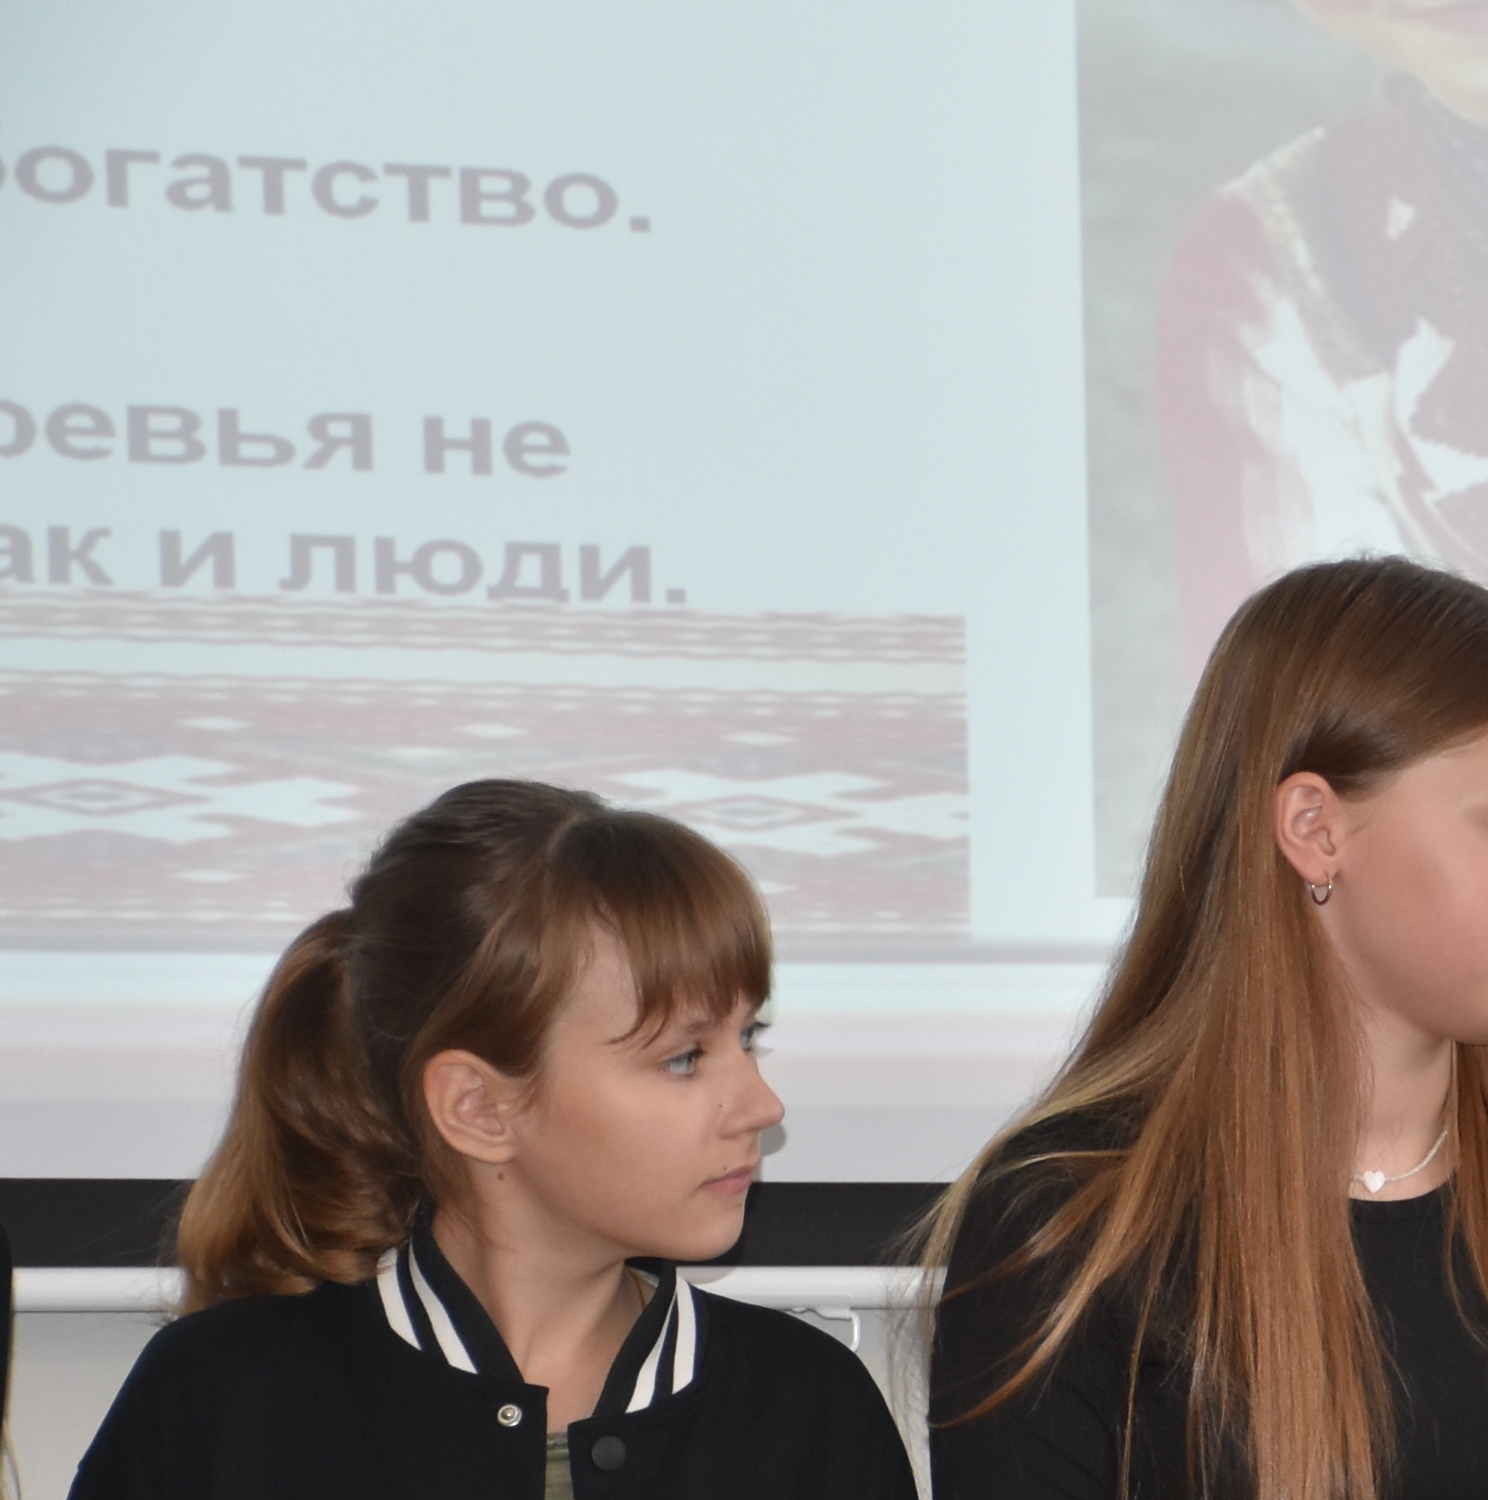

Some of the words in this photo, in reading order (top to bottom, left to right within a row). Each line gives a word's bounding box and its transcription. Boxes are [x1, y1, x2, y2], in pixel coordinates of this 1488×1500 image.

[0, 144, 652, 234] огатство.
[421, 415, 571, 479] не
[157, 528, 236, 590] и
[278, 531, 688, 606] люди.
